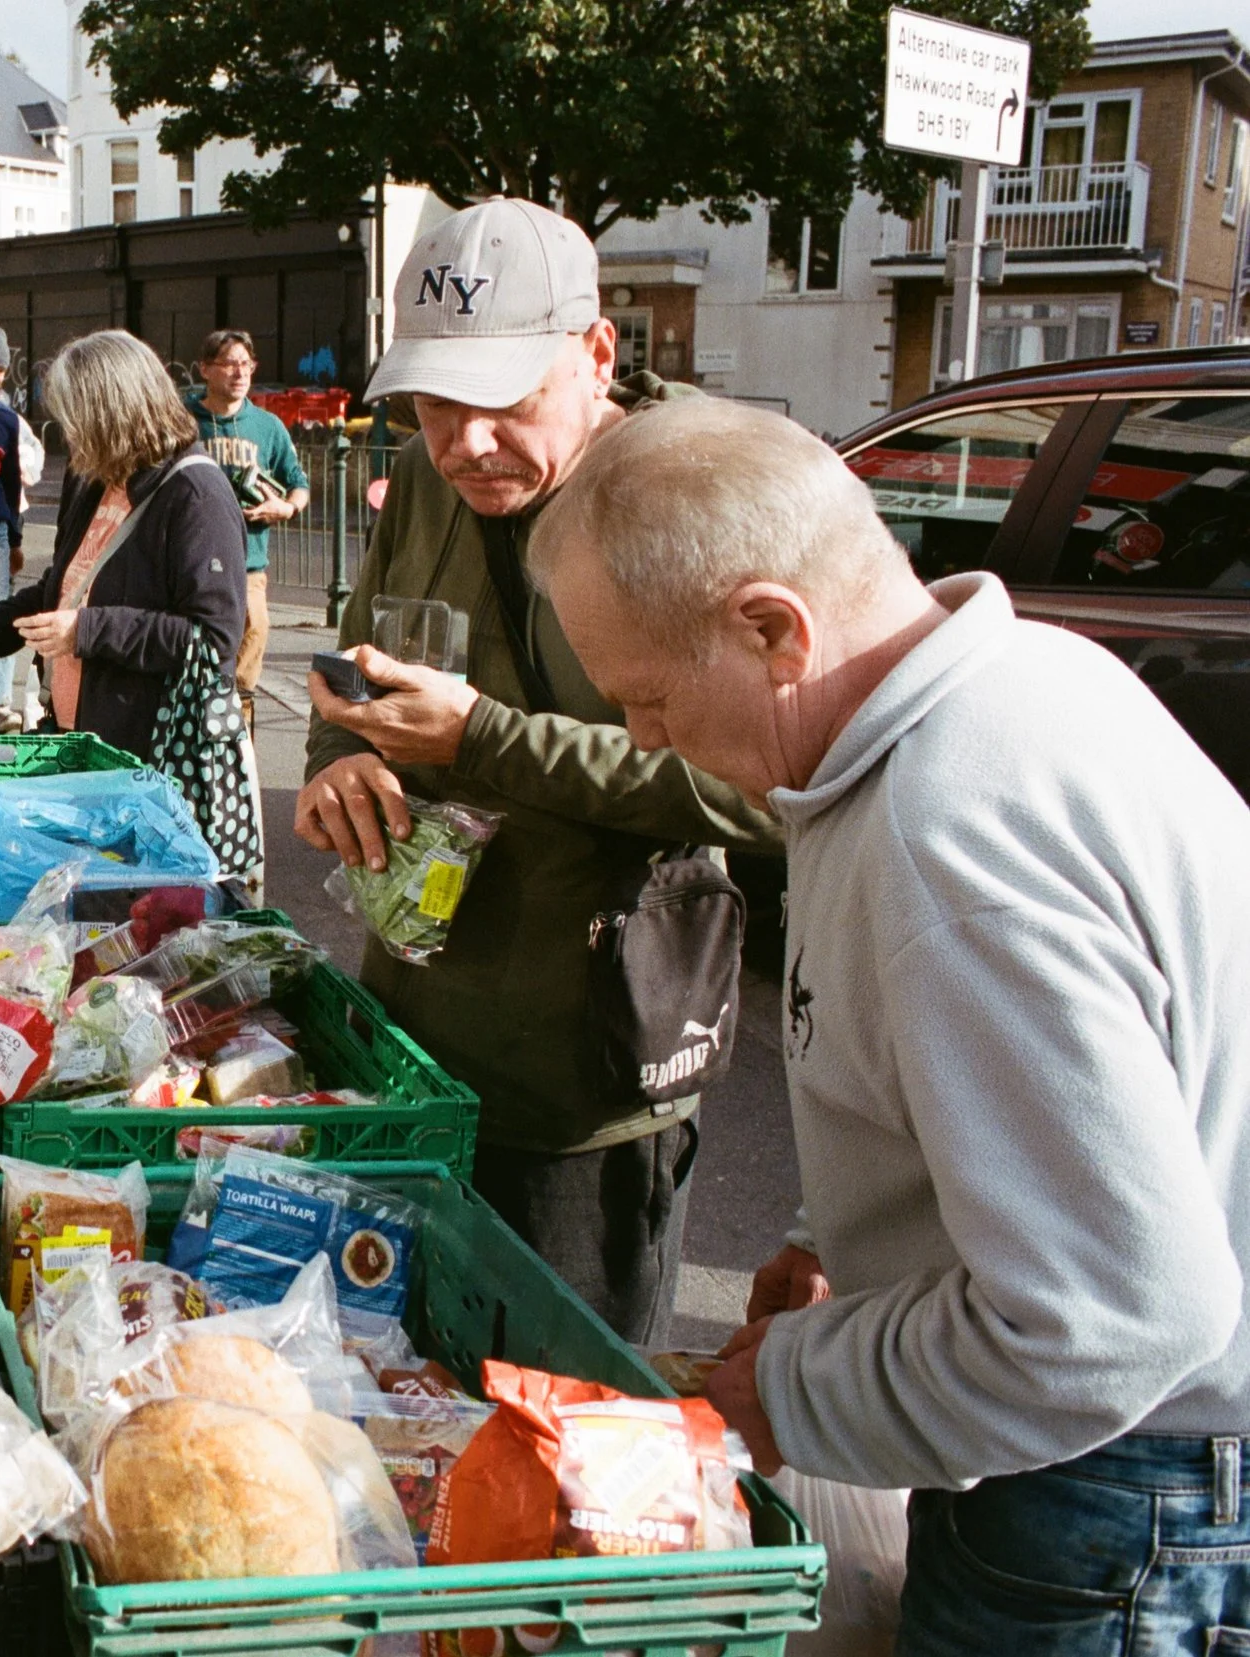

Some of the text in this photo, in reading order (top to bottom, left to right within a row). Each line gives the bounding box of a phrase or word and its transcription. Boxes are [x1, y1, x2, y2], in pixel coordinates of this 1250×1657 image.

[897, 26, 1021, 78] Alternative car park
[894, 65, 996, 108] Hawkwood Road
[917, 111, 971, 142] BH5 1BY
[415, 263, 491, 316] NY
[226, 1188, 317, 1223] TORTILLA WRAPS
